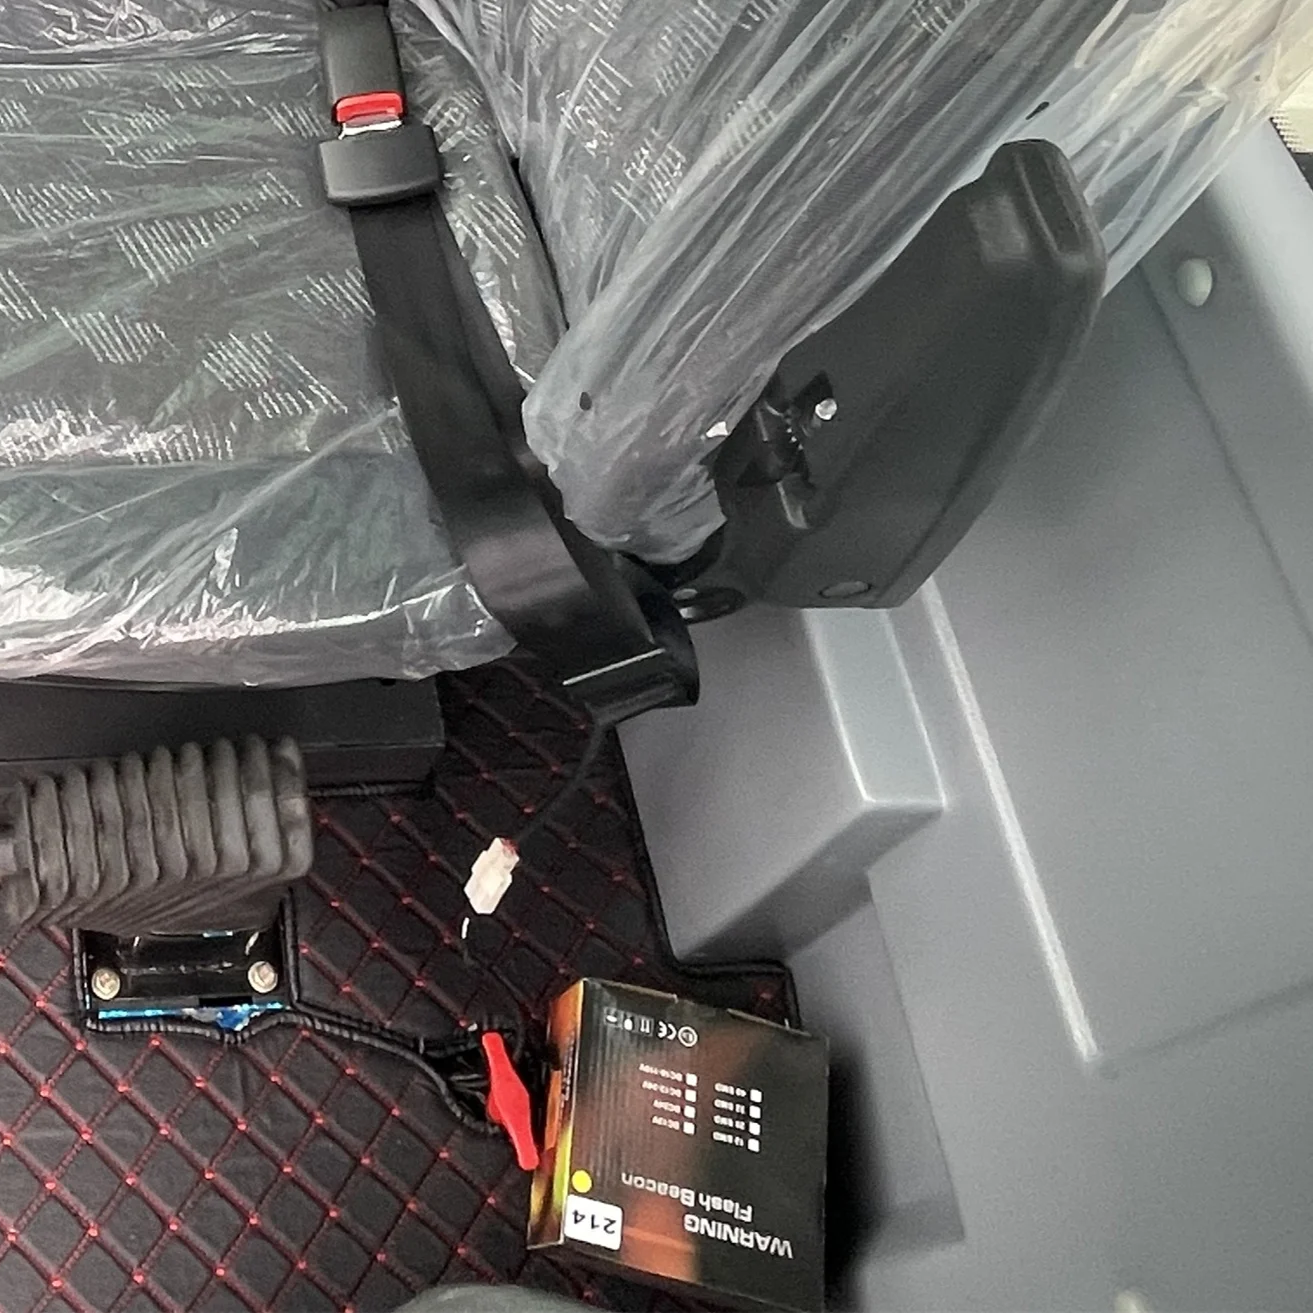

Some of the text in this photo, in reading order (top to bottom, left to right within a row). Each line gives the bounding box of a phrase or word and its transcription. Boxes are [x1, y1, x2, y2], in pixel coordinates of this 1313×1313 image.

[620, 1172, 752, 1222] Flash Beacon
[572, 1207, 617, 1235] 214
[683, 1214, 794, 1260] WARNING
